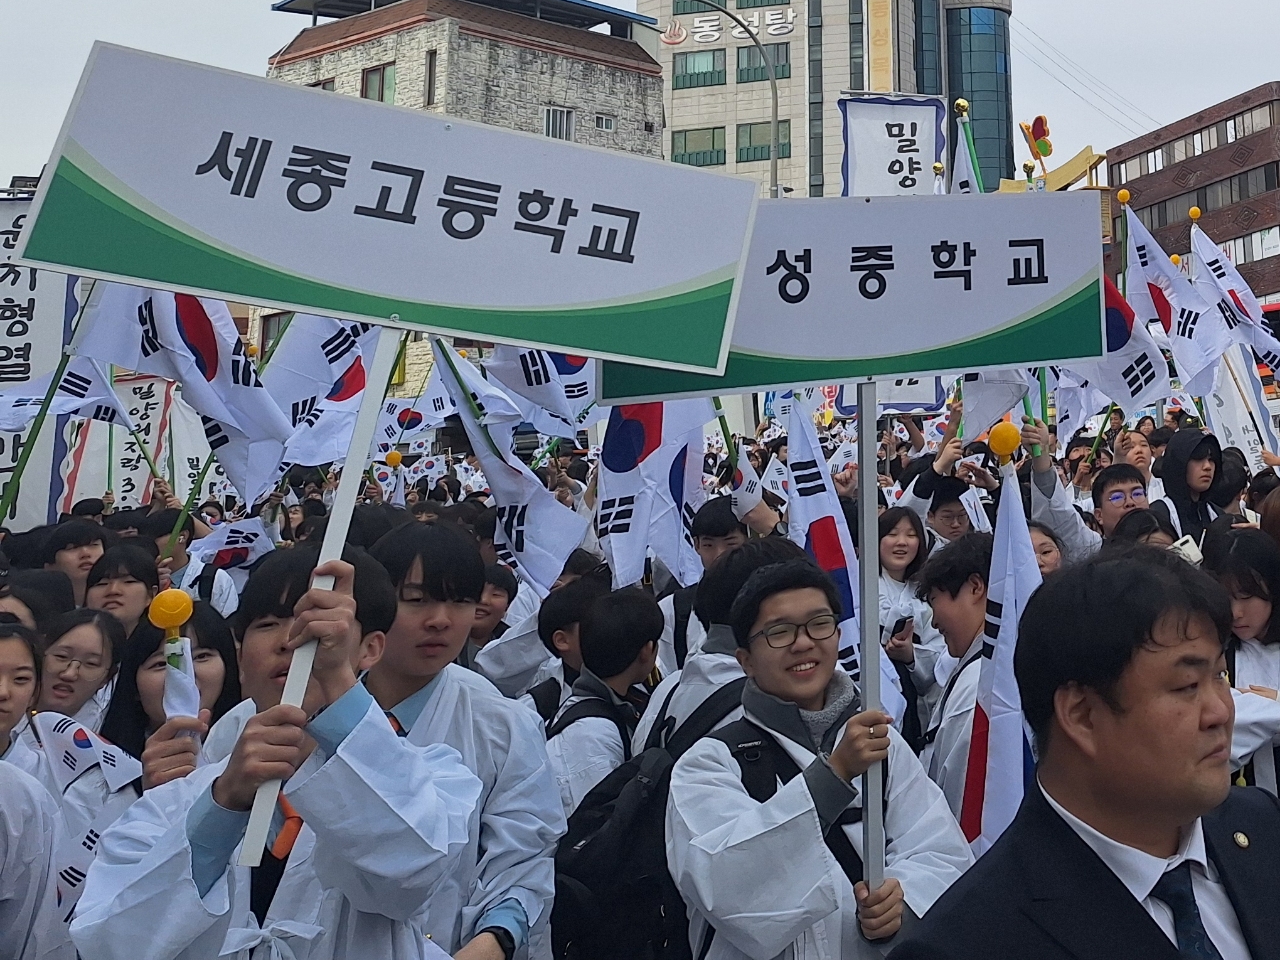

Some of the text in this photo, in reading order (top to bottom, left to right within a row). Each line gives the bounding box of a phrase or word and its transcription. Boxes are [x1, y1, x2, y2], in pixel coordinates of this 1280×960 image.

[690, 6, 797, 44] 동성탕
[194, 130, 641, 264] 세종고등학교
[765, 238, 1049, 304] 성중학교
